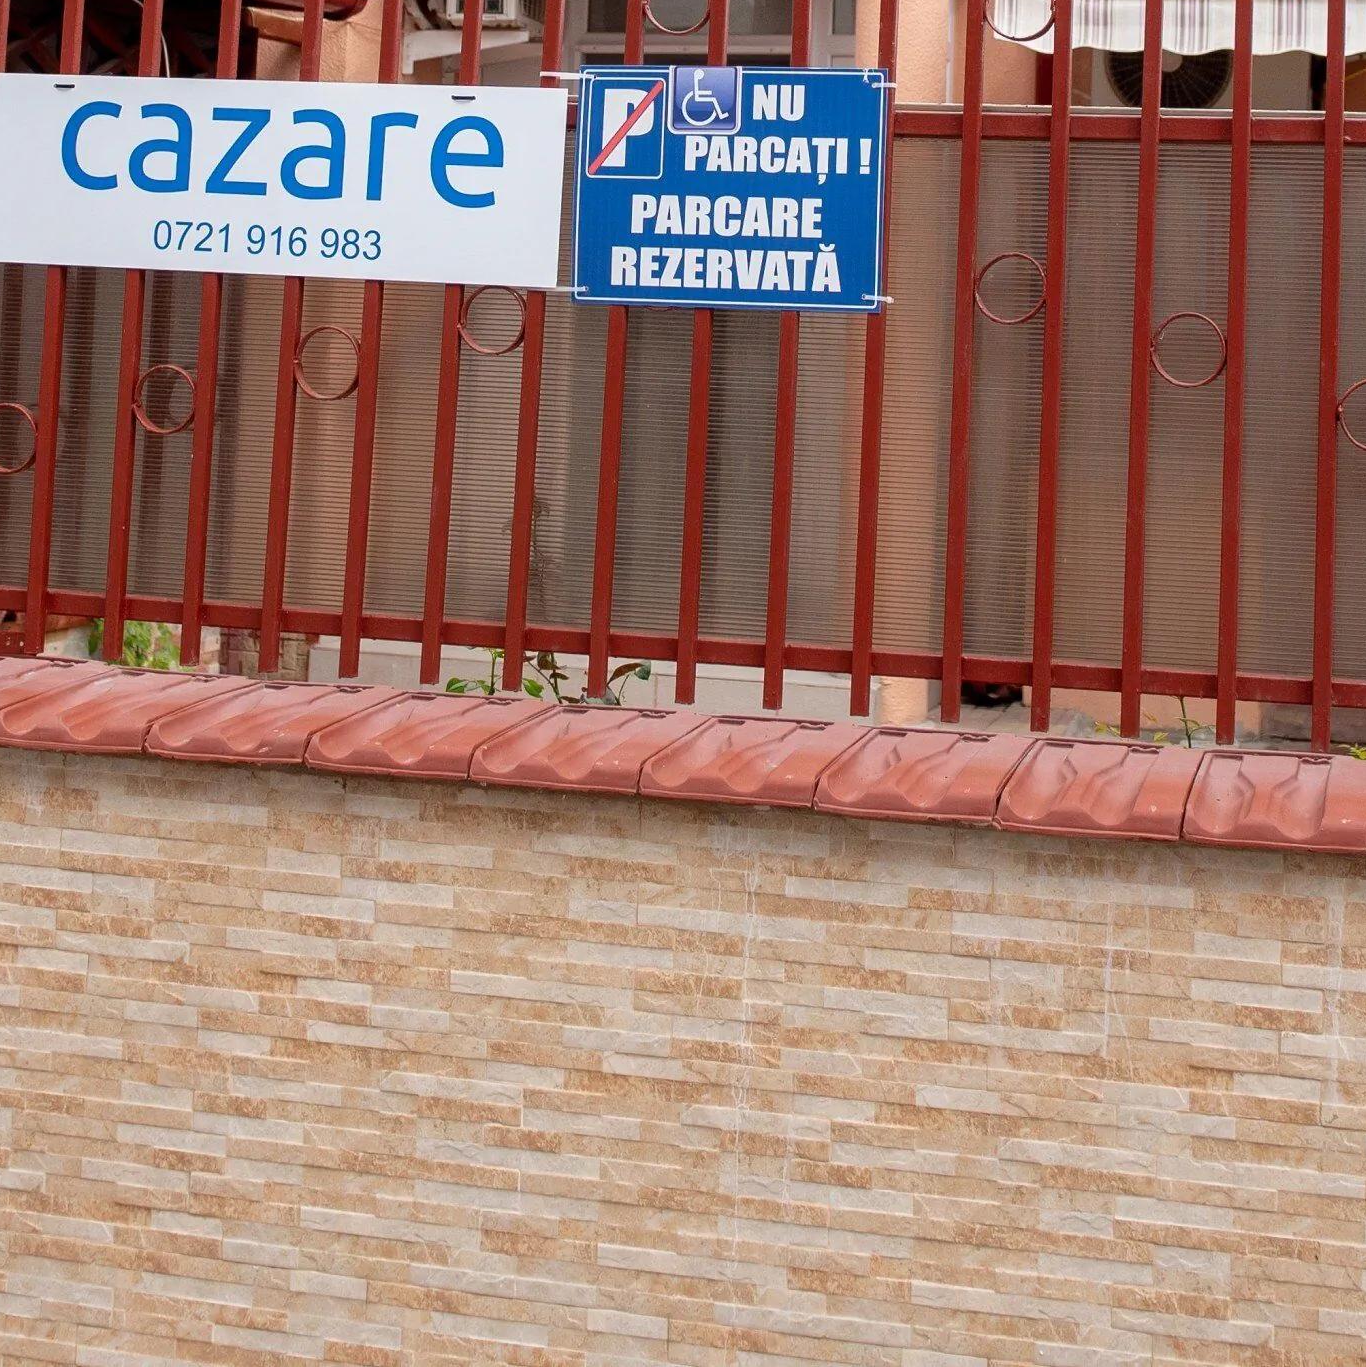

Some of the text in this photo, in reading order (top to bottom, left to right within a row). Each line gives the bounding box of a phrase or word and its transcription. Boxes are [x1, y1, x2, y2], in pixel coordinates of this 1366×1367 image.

[752, 84, 805, 121] NU
[60, 100, 505, 209] cazare
[684, 135, 848, 185] PARCAȚI
[630, 194, 823, 238] PARCARE
[153, 220, 382, 260] 0721 916 983
[610, 243, 842, 293] REZERVATĂ
